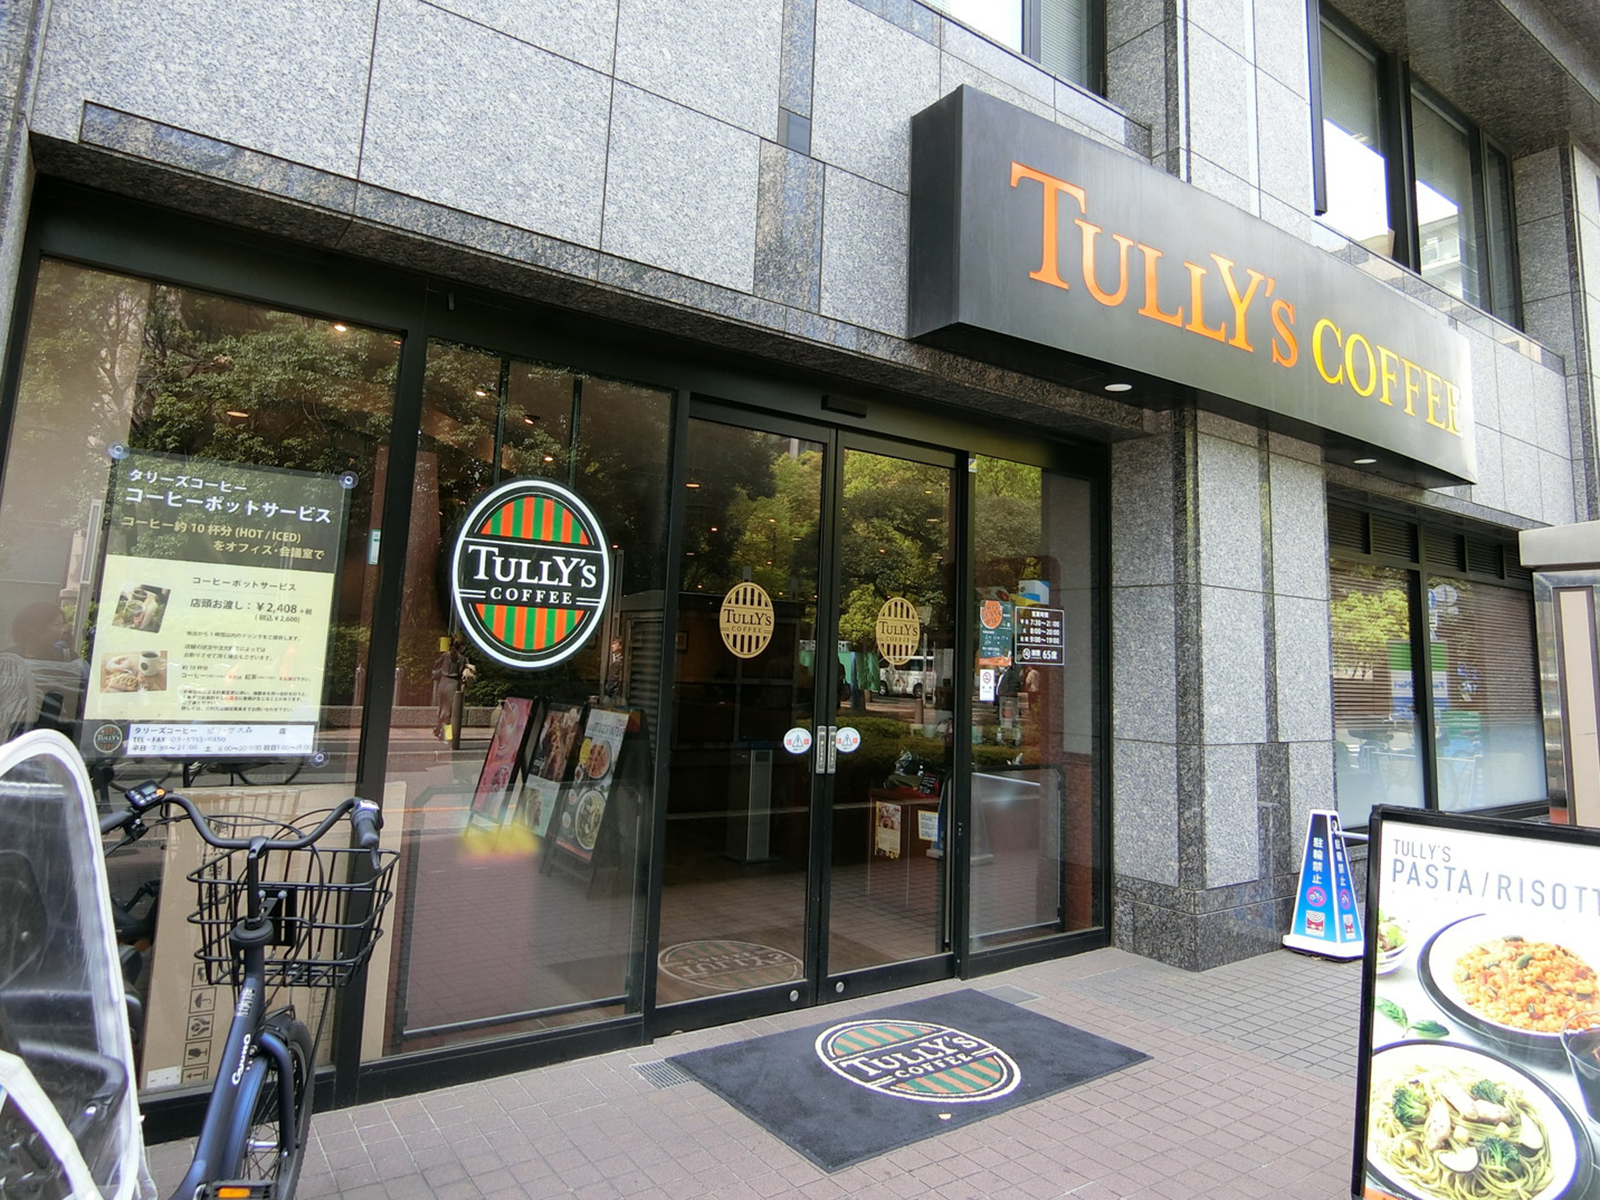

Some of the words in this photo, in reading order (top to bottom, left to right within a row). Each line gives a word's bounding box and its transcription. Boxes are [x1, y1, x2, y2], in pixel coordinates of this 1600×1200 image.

[1010, 161, 1298, 368] TULLY'S
[1312, 318, 1463, 438] COFFEE
[130, 469, 247, 493] タリーズコーヒー
[126, 488, 332, 524] コーヒーポットサービス
[213, 540, 325, 560] をオフィス・会議室で
[468, 544, 597, 588] TULLY'S
[193, 576, 296, 592] コーヒーポットサービス
[490, 586, 572, 605] COFFEE
[724, 609, 772, 627] TULLY'S
[731, 626, 763, 634] COFFEE
[879, 620, 918, 637] TULLY'S
[134, 726, 197, 735] タリーズコーヒー
[1312, 837, 1324, 885] 駐輪禁止
[1393, 838, 1452, 863] TULLY'S
[841, 1035, 979, 1077] TULLY'S
[894, 1052, 973, 1078] COFFEE
